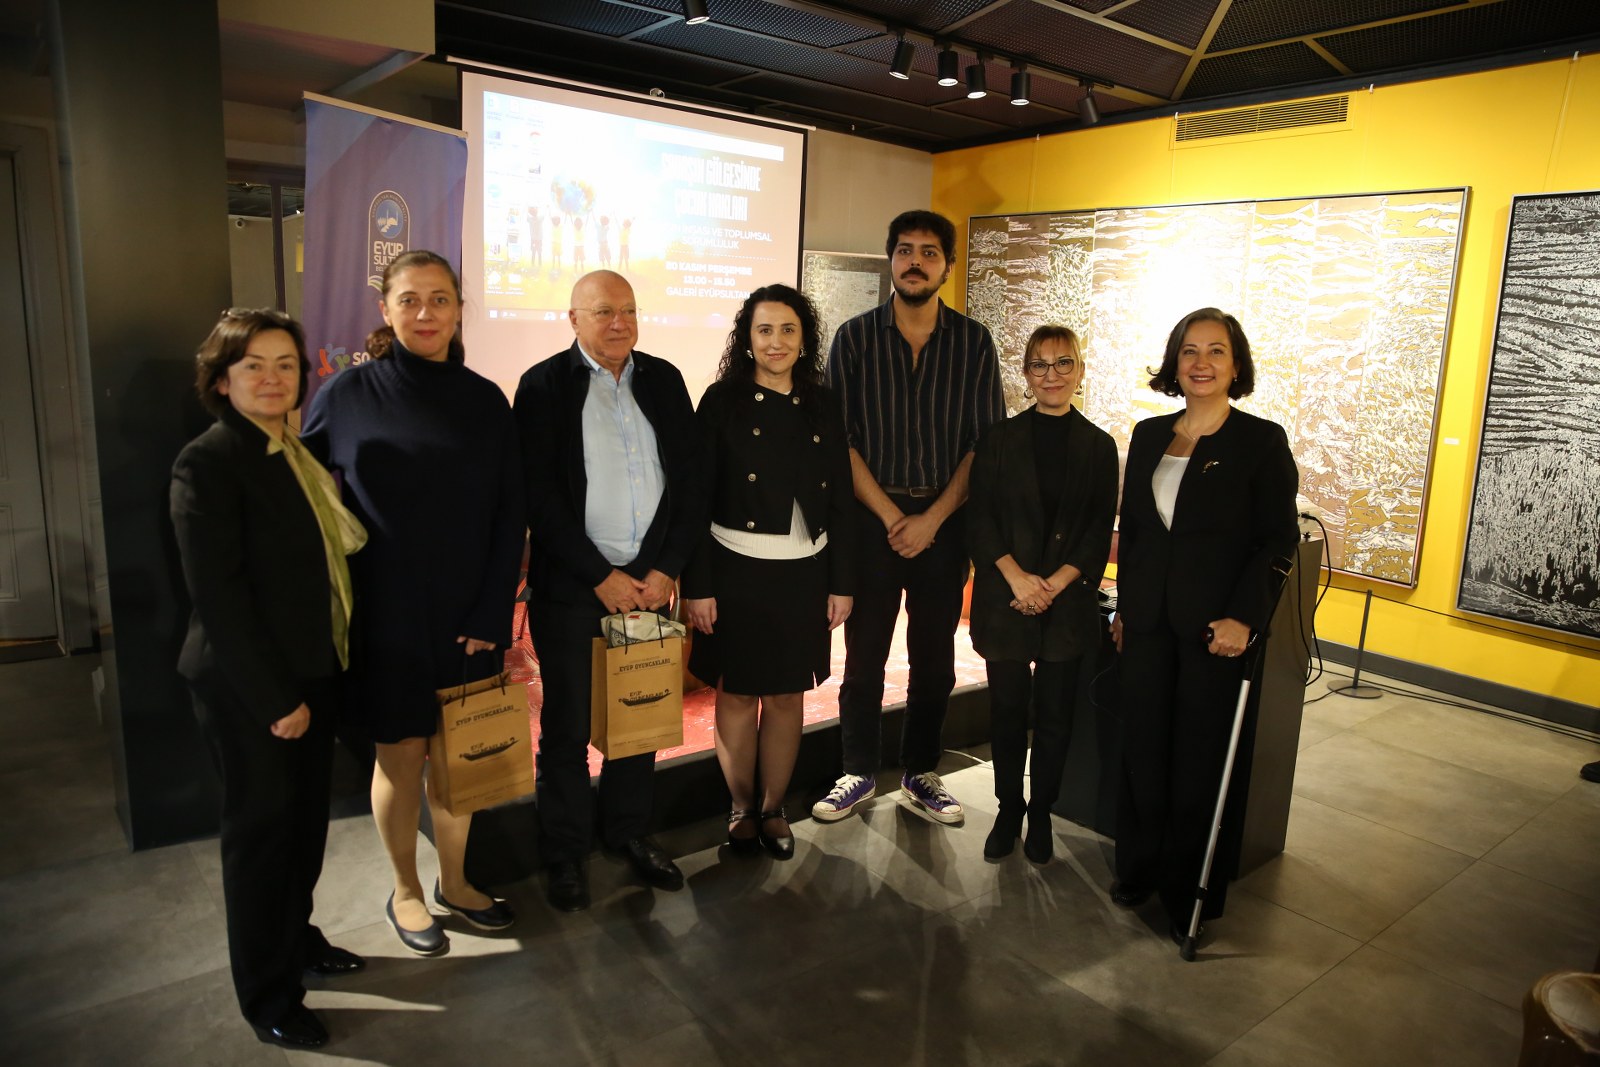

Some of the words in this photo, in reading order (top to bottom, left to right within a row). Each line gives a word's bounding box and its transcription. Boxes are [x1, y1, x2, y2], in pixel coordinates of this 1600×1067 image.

[706, 156, 761, 191] GÖLGESİNDE
[712, 228, 723, 237] VE
[725, 229, 773, 242] TOPLUMSAL
[373, 241, 404, 257] EYÜP
[373, 255, 397, 266] SULT
[679, 262, 707, 272] KASIM
[708, 264, 752, 276] PERŞEMBE
[666, 286, 697, 297] GALERİ
[698, 287, 751, 299] EYÜPSULTAN
